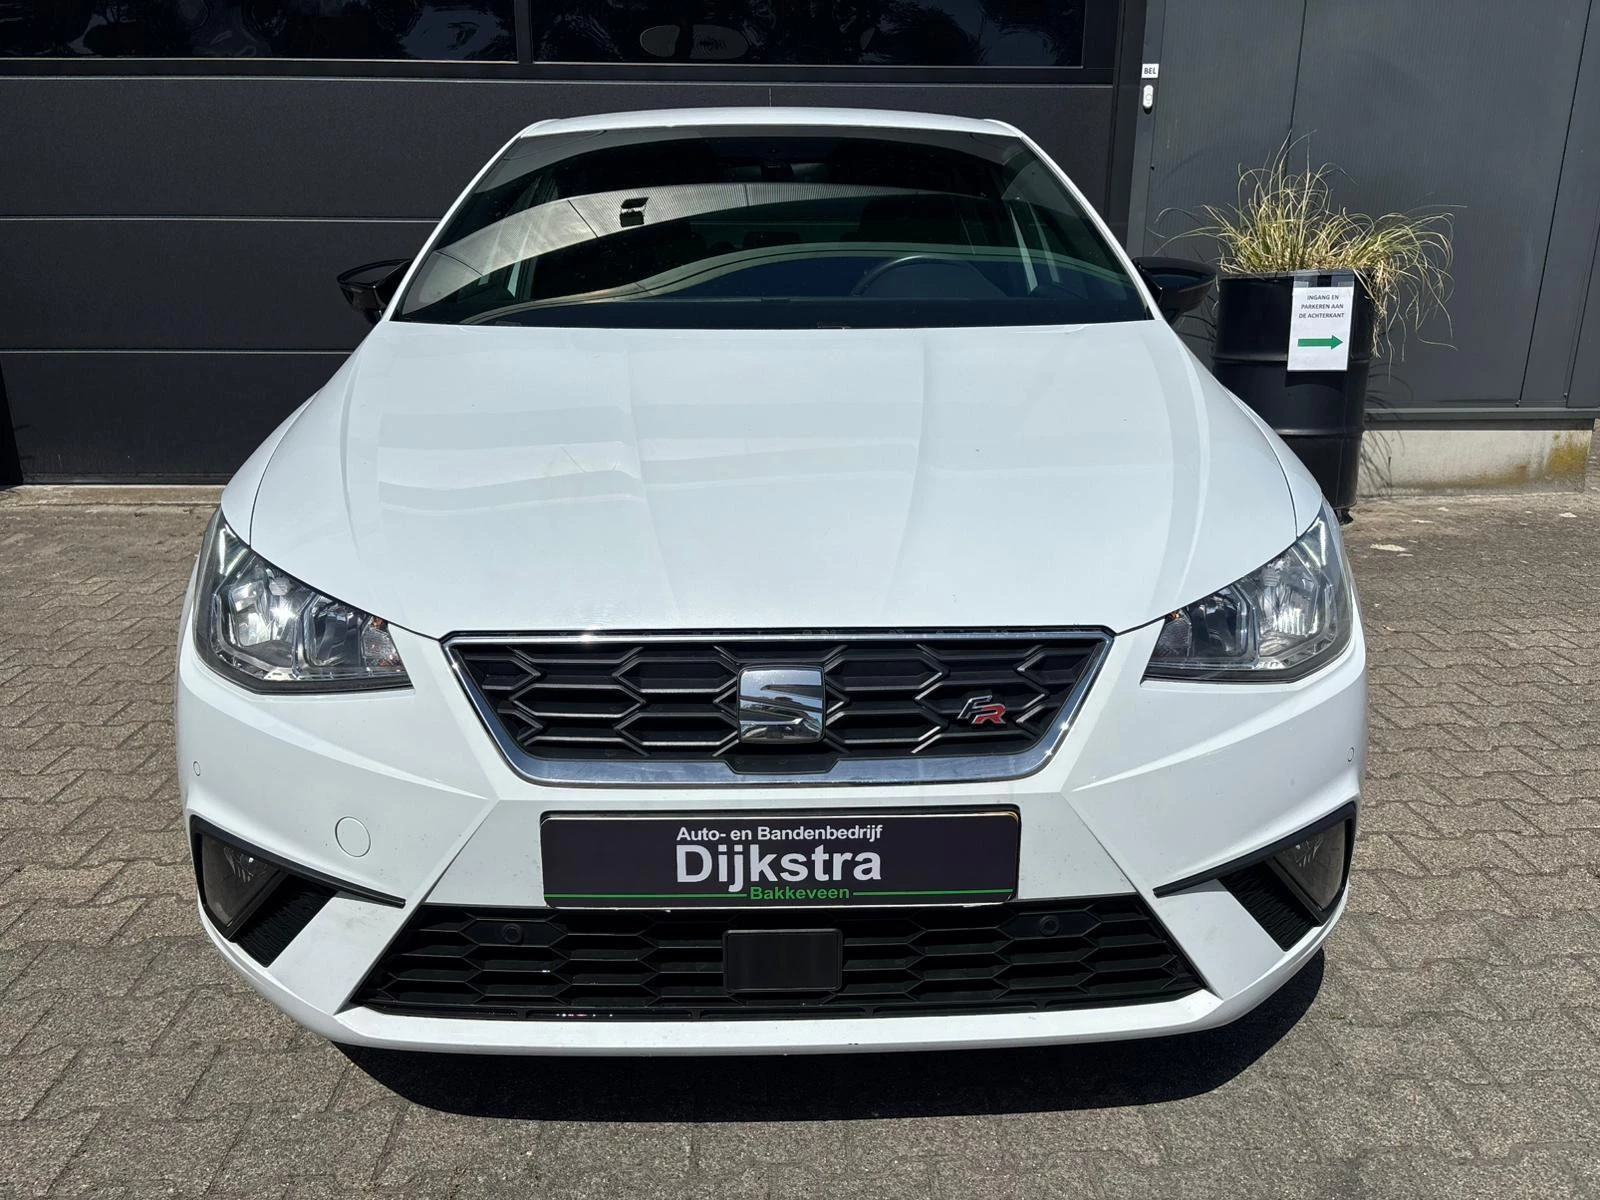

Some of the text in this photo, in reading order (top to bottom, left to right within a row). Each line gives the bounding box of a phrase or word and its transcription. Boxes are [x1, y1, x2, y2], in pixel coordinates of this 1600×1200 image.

[1144, 67, 1156, 75] BEL
[957, 694, 1006, 724] FR
[676, 824, 883, 842] Auto- en Bandenbedrijf
[676, 844, 882, 893] Dijkstra
[750, 886, 850, 900] Bakkeveen
